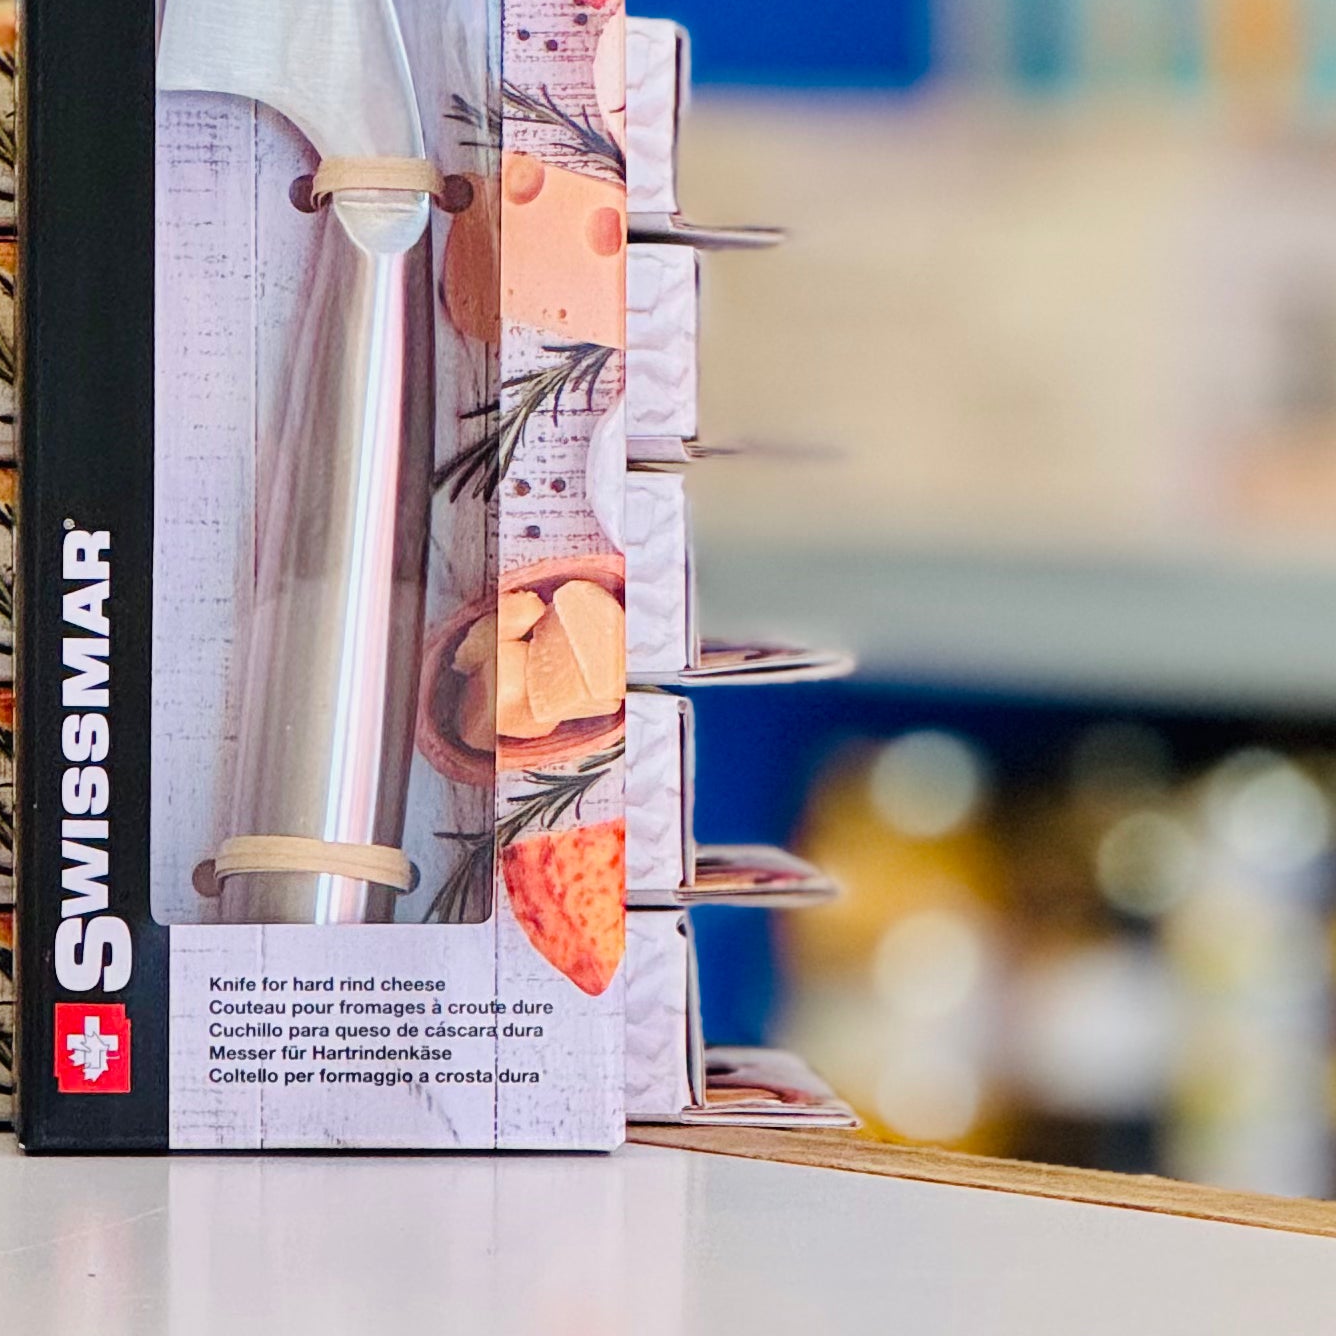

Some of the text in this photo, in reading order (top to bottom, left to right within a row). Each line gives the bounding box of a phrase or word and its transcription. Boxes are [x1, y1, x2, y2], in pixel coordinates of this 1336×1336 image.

[208, 976, 446, 991] Knife for hard rind cheese
[208, 999, 286, 1014] Couteau
[291, 1002, 334, 1017] pour
[338, 999, 425, 1017] fromages
[431, 997, 442, 1014] à
[511, 999, 553, 1014] dure
[208, 1021, 543, 1040] Cuchillo para queso de cáscara dura
[208, 1045, 452, 1059] Messer für Hartrindenkäse
[208, 1068, 539, 1085] Coltello per formaggio a crosta dura
